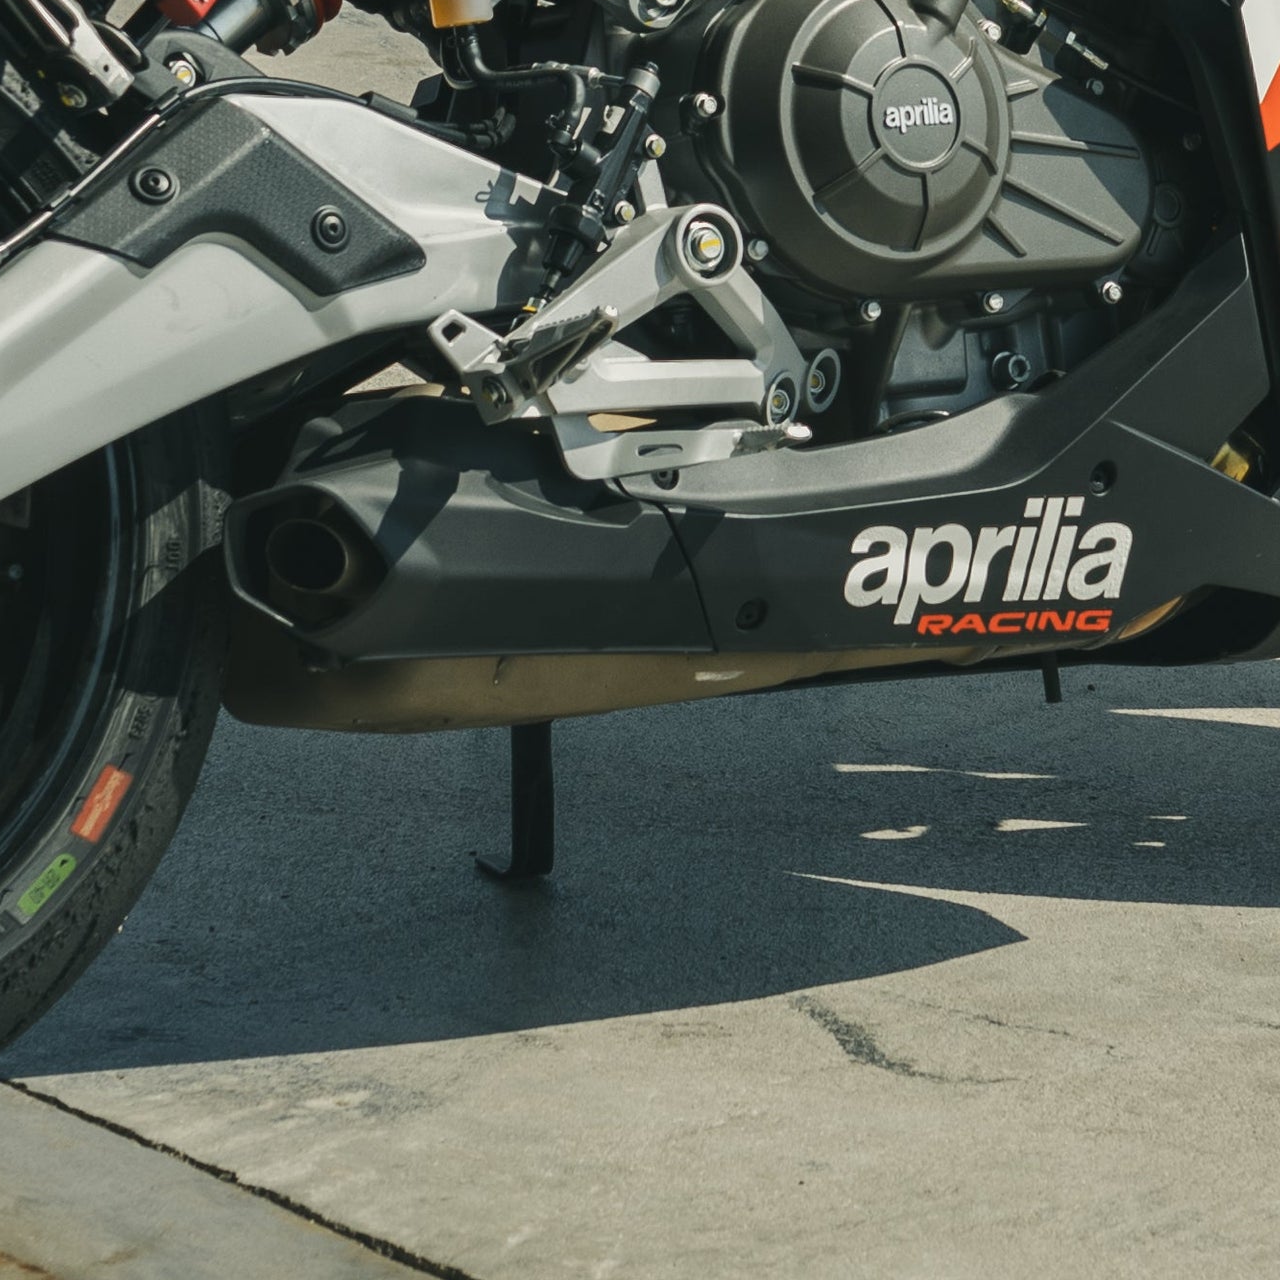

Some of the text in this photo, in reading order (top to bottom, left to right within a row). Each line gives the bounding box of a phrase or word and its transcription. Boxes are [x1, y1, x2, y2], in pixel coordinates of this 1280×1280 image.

[884, 96, 954, 134] aprilia
[843, 496, 1134, 626] aprilia
[917, 609, 1113, 636] RACING
